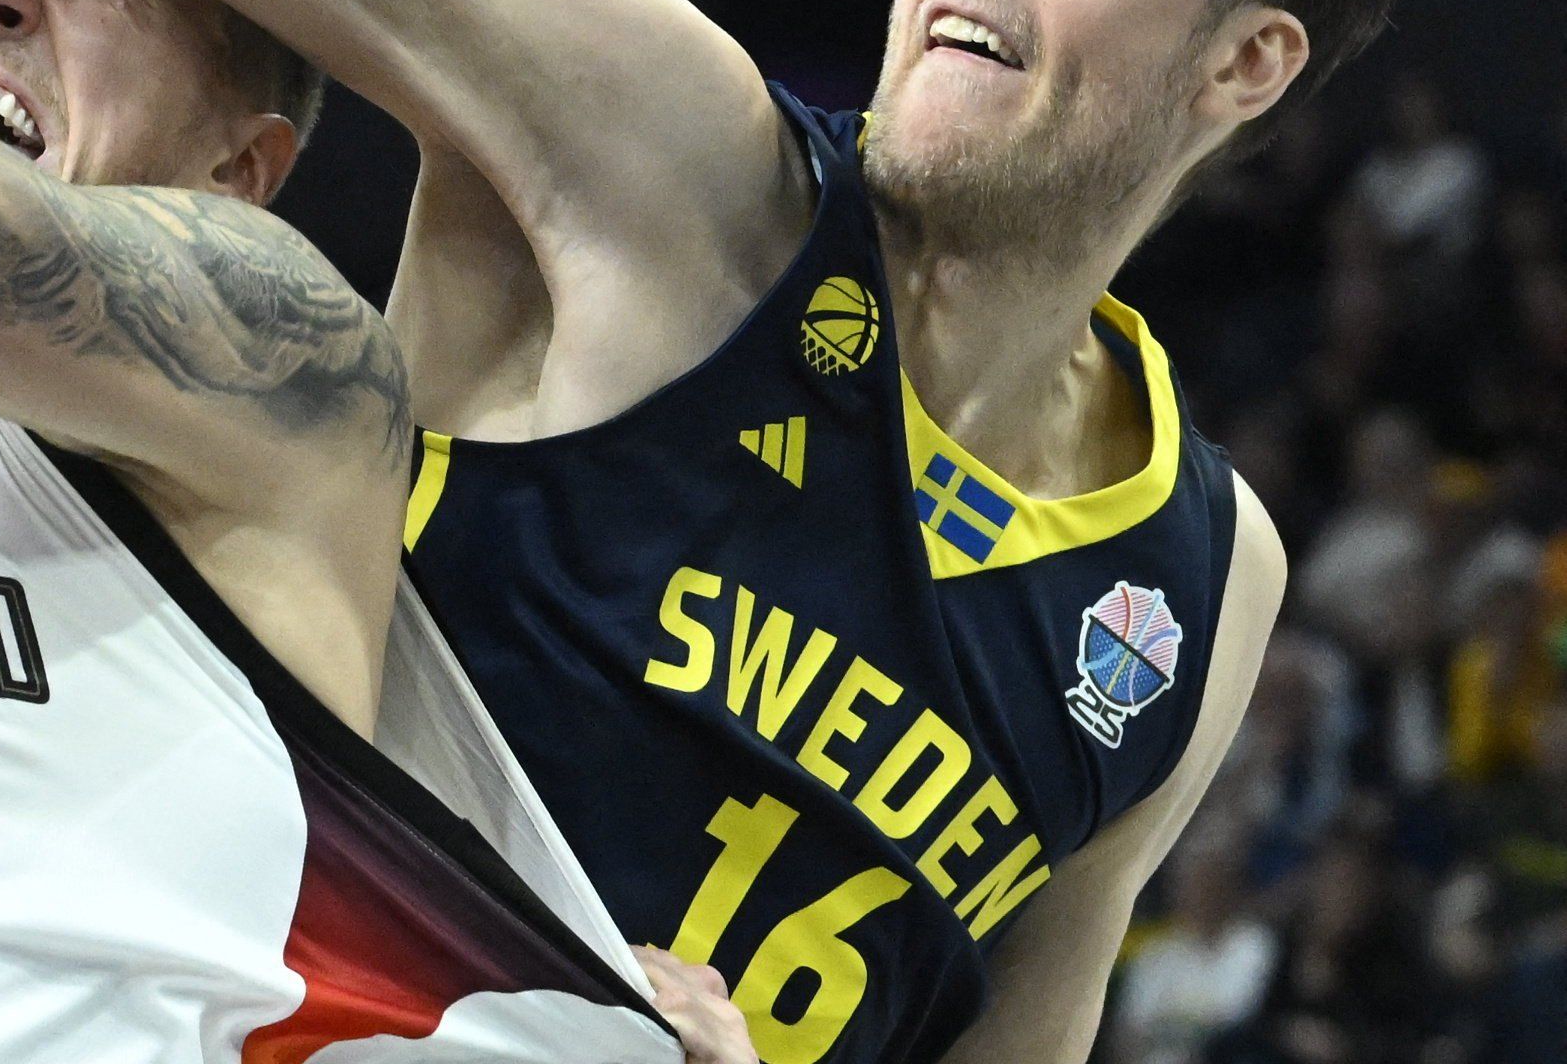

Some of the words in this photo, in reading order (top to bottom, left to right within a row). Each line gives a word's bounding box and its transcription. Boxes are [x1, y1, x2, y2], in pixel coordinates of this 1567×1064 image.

[644, 567, 1052, 942] SWEDEN
[1066, 685, 1122, 745] 25
[646, 793, 913, 1064] 16
